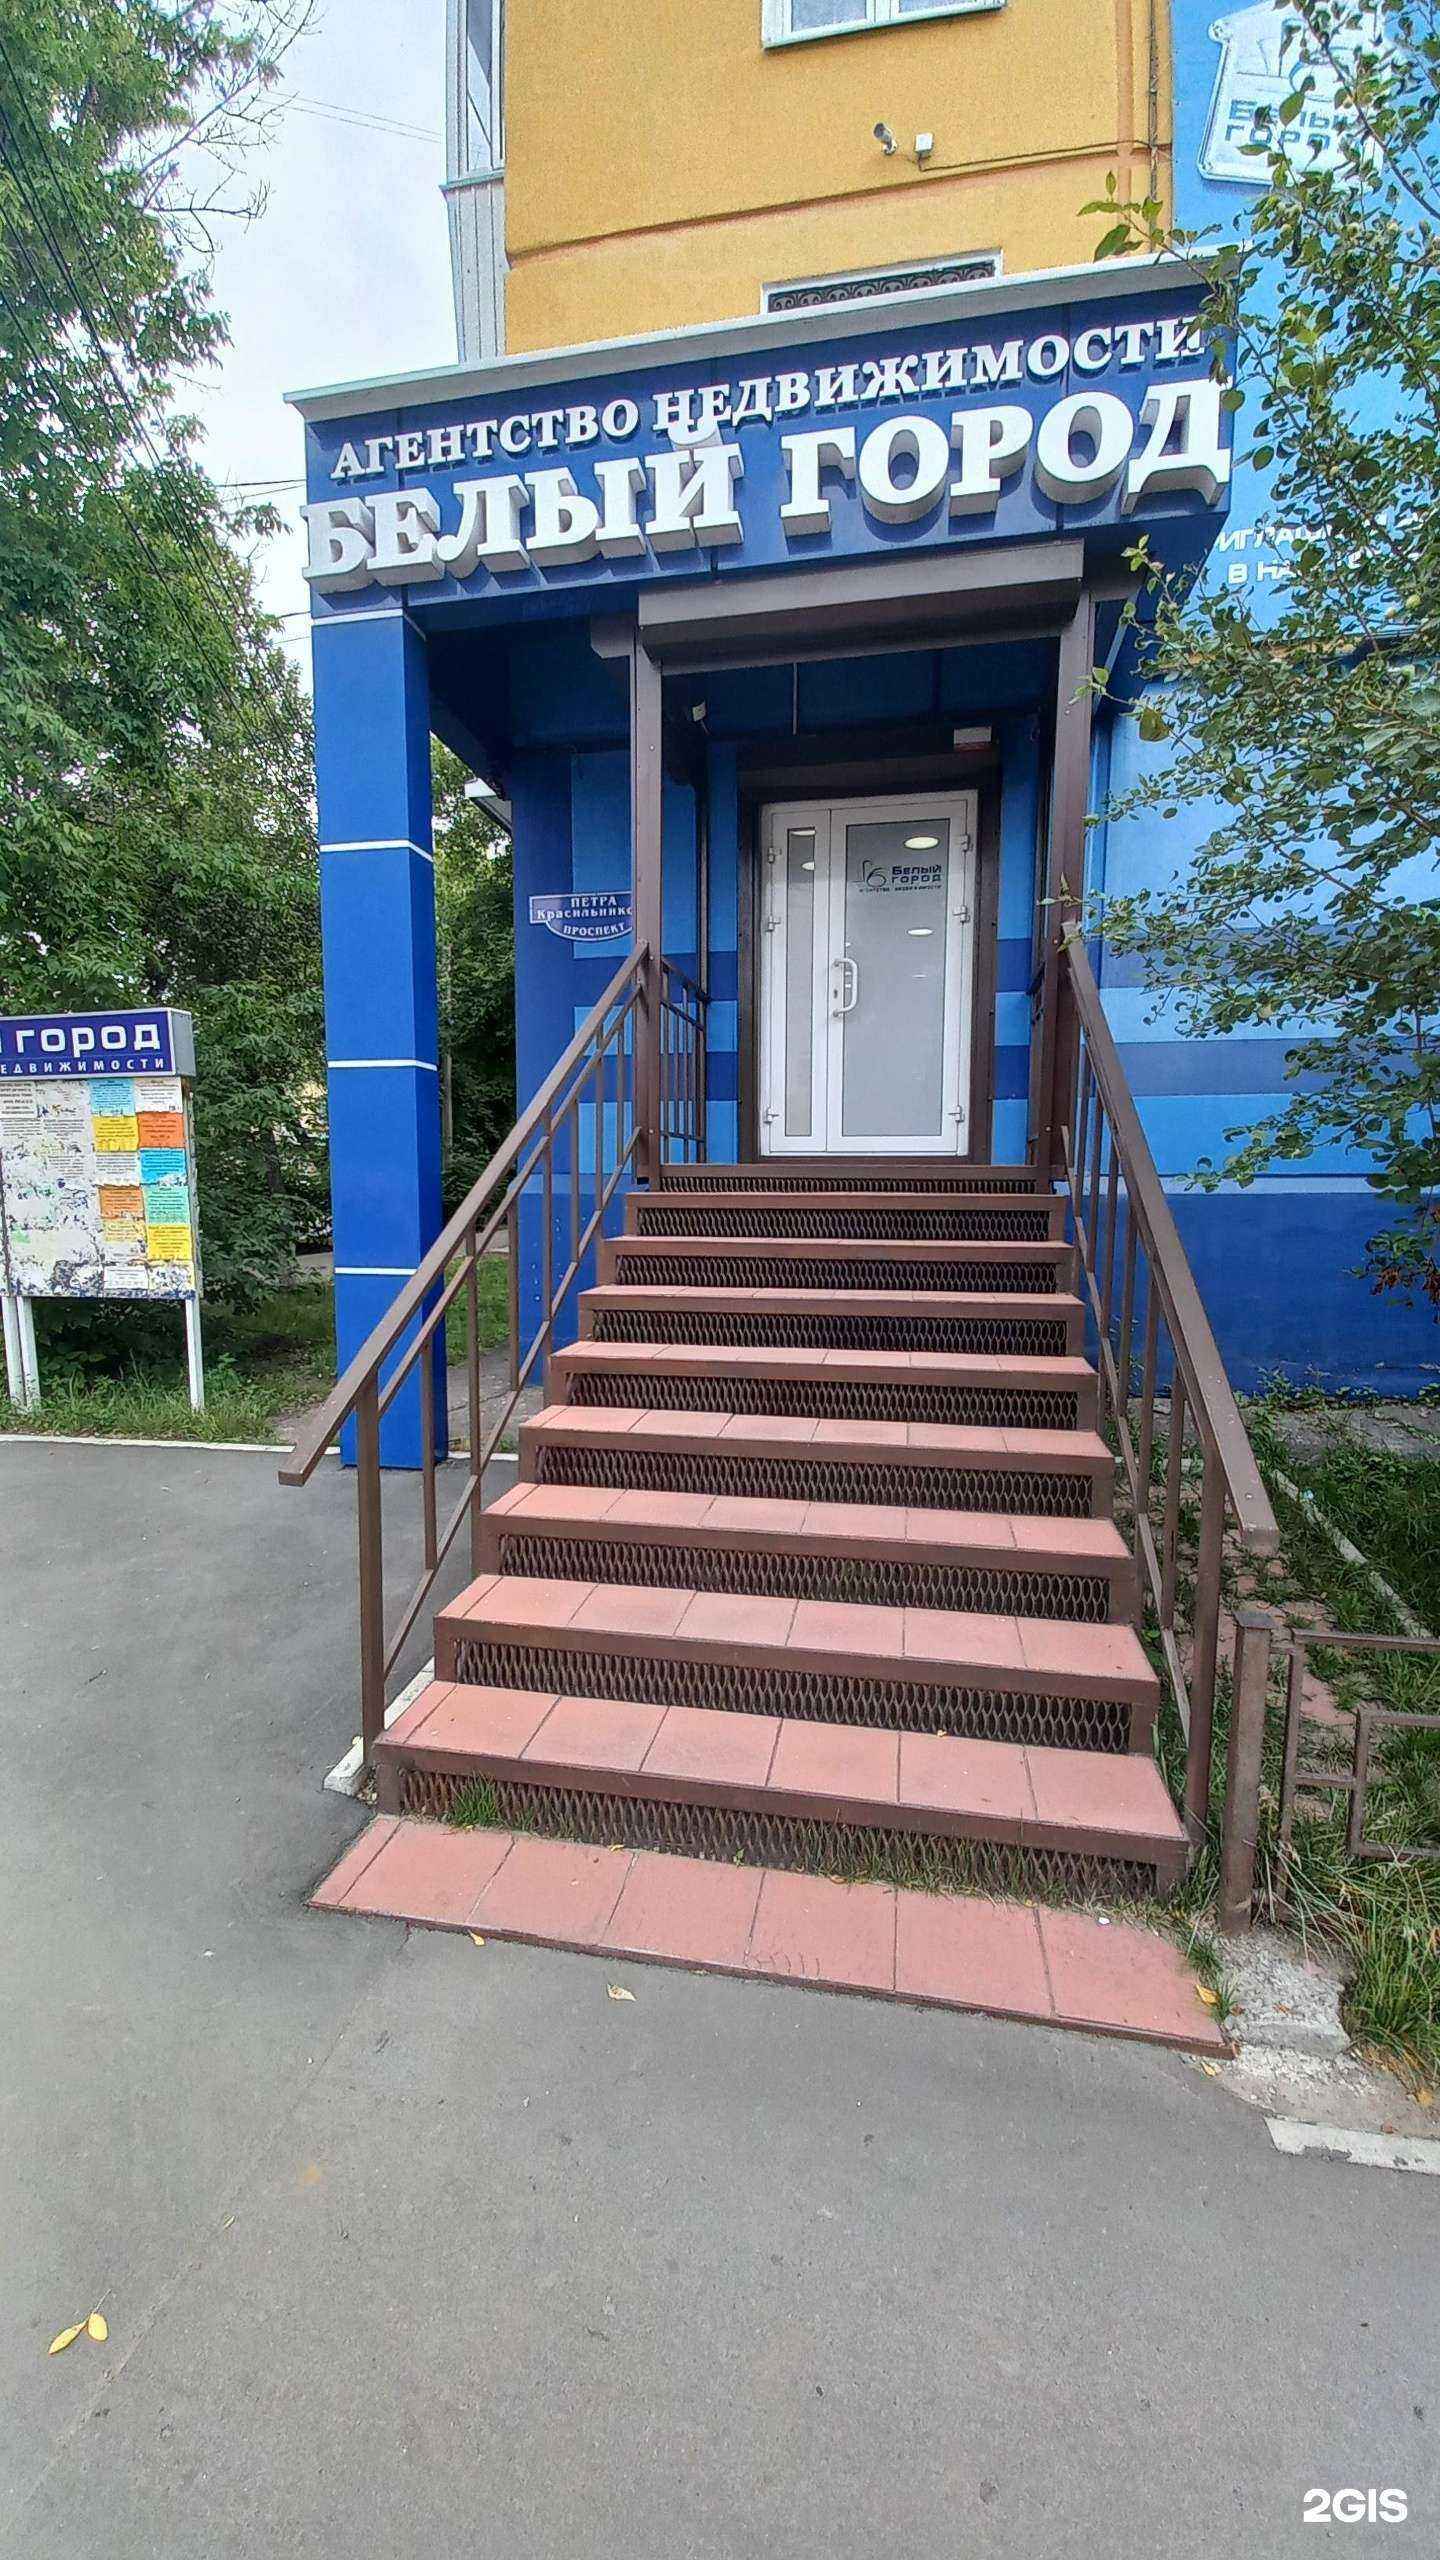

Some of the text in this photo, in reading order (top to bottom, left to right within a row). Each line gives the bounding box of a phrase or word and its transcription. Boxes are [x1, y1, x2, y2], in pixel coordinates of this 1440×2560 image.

[331, 315, 1205, 480] АГЕНТСТВО НЕДВИЖИМОСТИ
[301, 374, 1232, 580] БЕЛЫЙ ГОРОД
[570, 896, 617, 908] ПЕТРА
[563, 922, 625, 936] ПРОСПЕКТ
[0, 1058, 164, 1074] ЕДВИЖИМОСТИ
